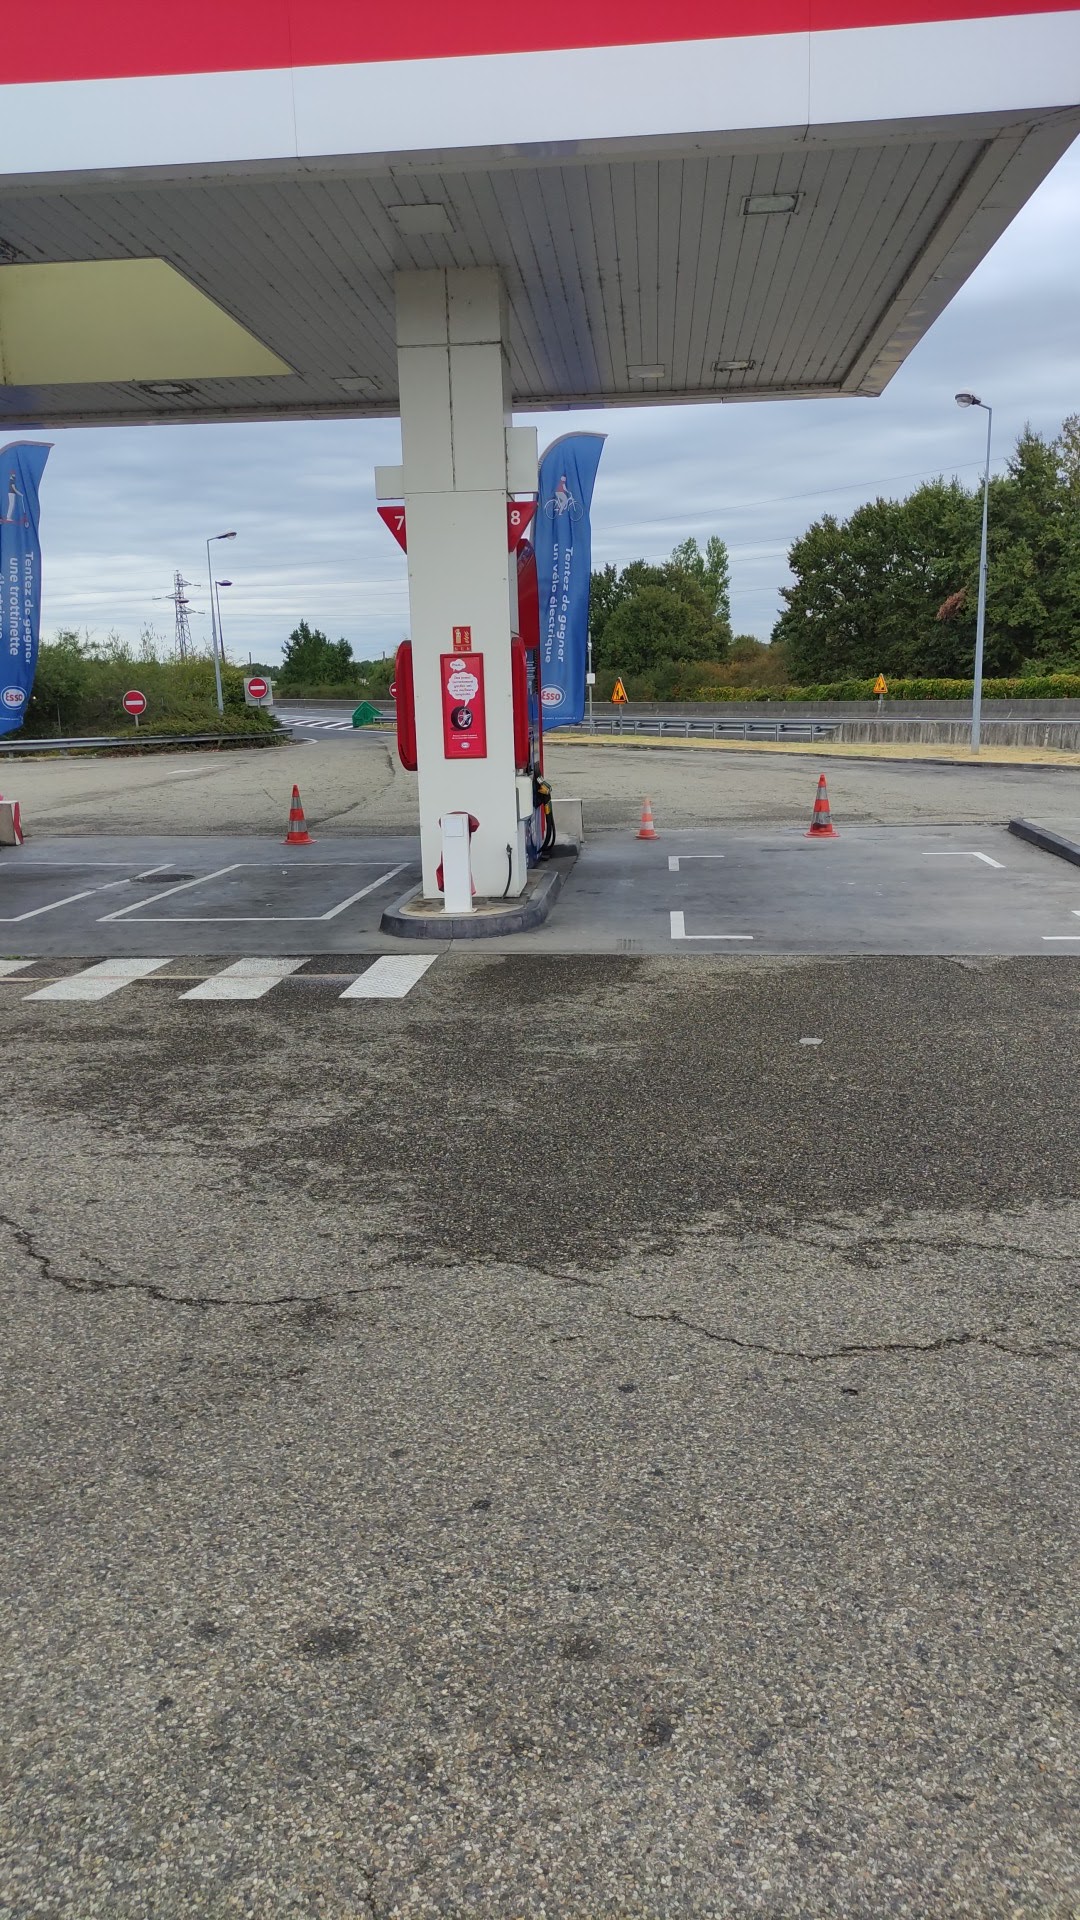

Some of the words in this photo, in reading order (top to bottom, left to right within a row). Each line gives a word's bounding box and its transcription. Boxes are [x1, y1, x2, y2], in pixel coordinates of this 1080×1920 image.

[394, 515, 405, 531] 7
[510, 510, 520, 525] 8
[553, 543, 559, 560] un
[9, 557, 19, 583] une
[24, 551, 34, 596] Tentez
[551, 564, 560, 593] vélo
[563, 546, 573, 592] Tentez
[24, 599, 34, 615] de
[562, 594, 571, 611] de
[9, 585, 21, 656] trottinette
[545, 596, 558, 663] électrique
[22, 618, 32, 664] gagner
[557, 614, 568, 662] gagner
